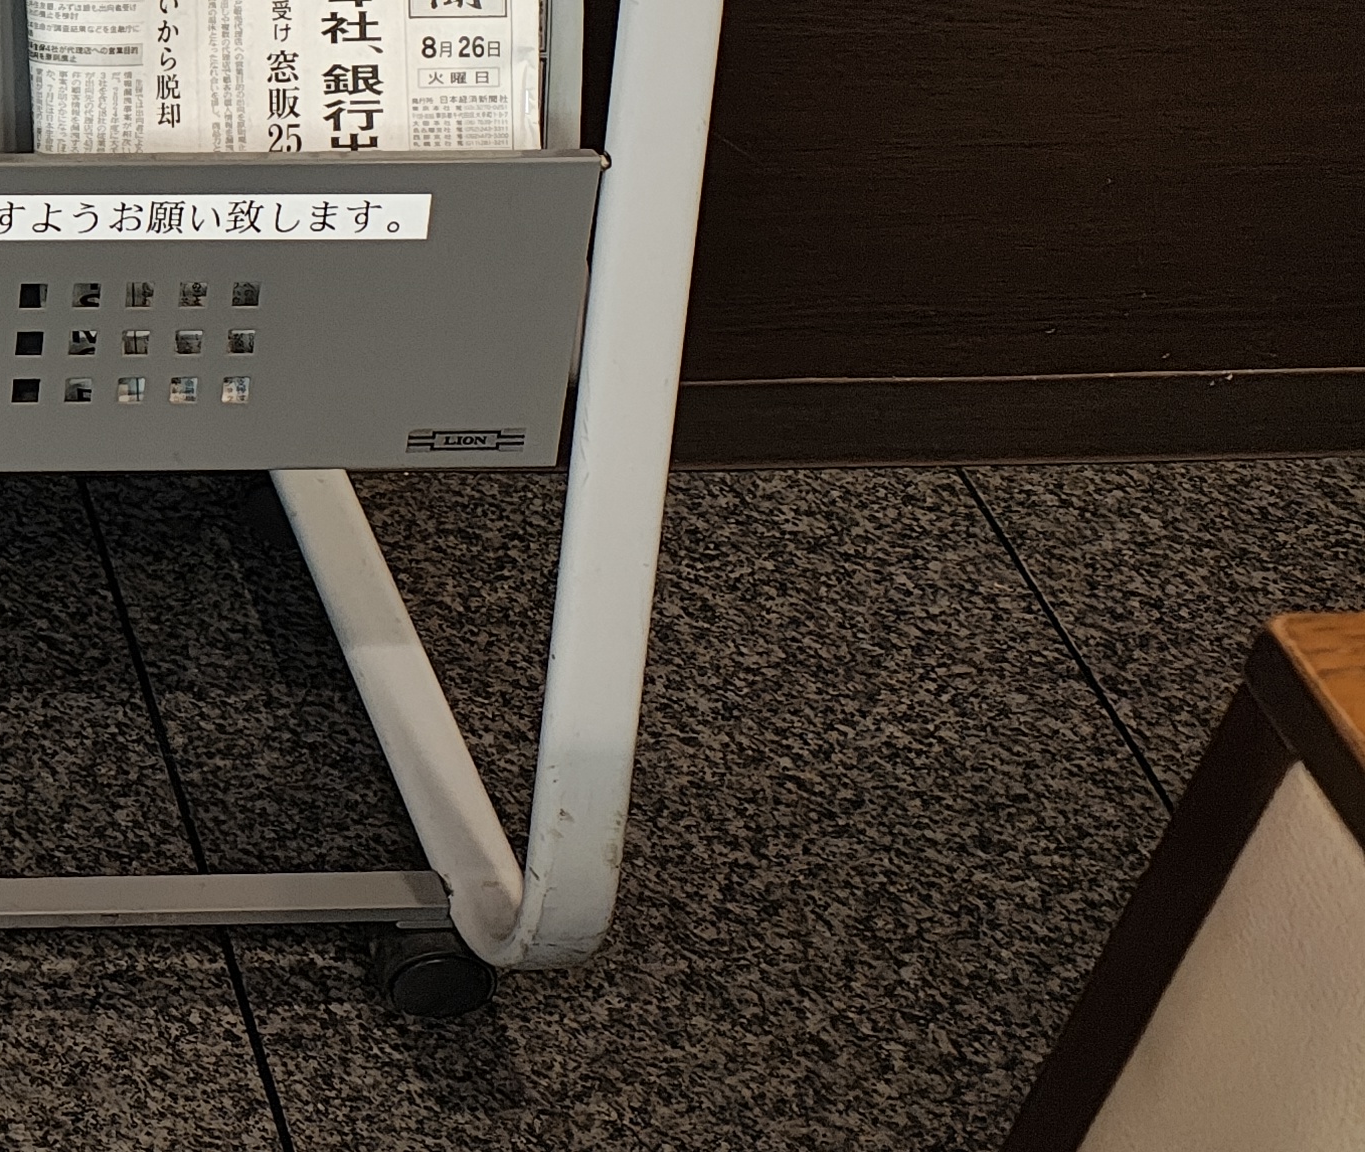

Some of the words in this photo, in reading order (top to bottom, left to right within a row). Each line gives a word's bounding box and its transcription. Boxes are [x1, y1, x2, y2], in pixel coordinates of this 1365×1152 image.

[421, 36, 501, 59] 8月26日
[428, 71, 489, 85] 火曜日
[443, 435, 487, 445] LION
